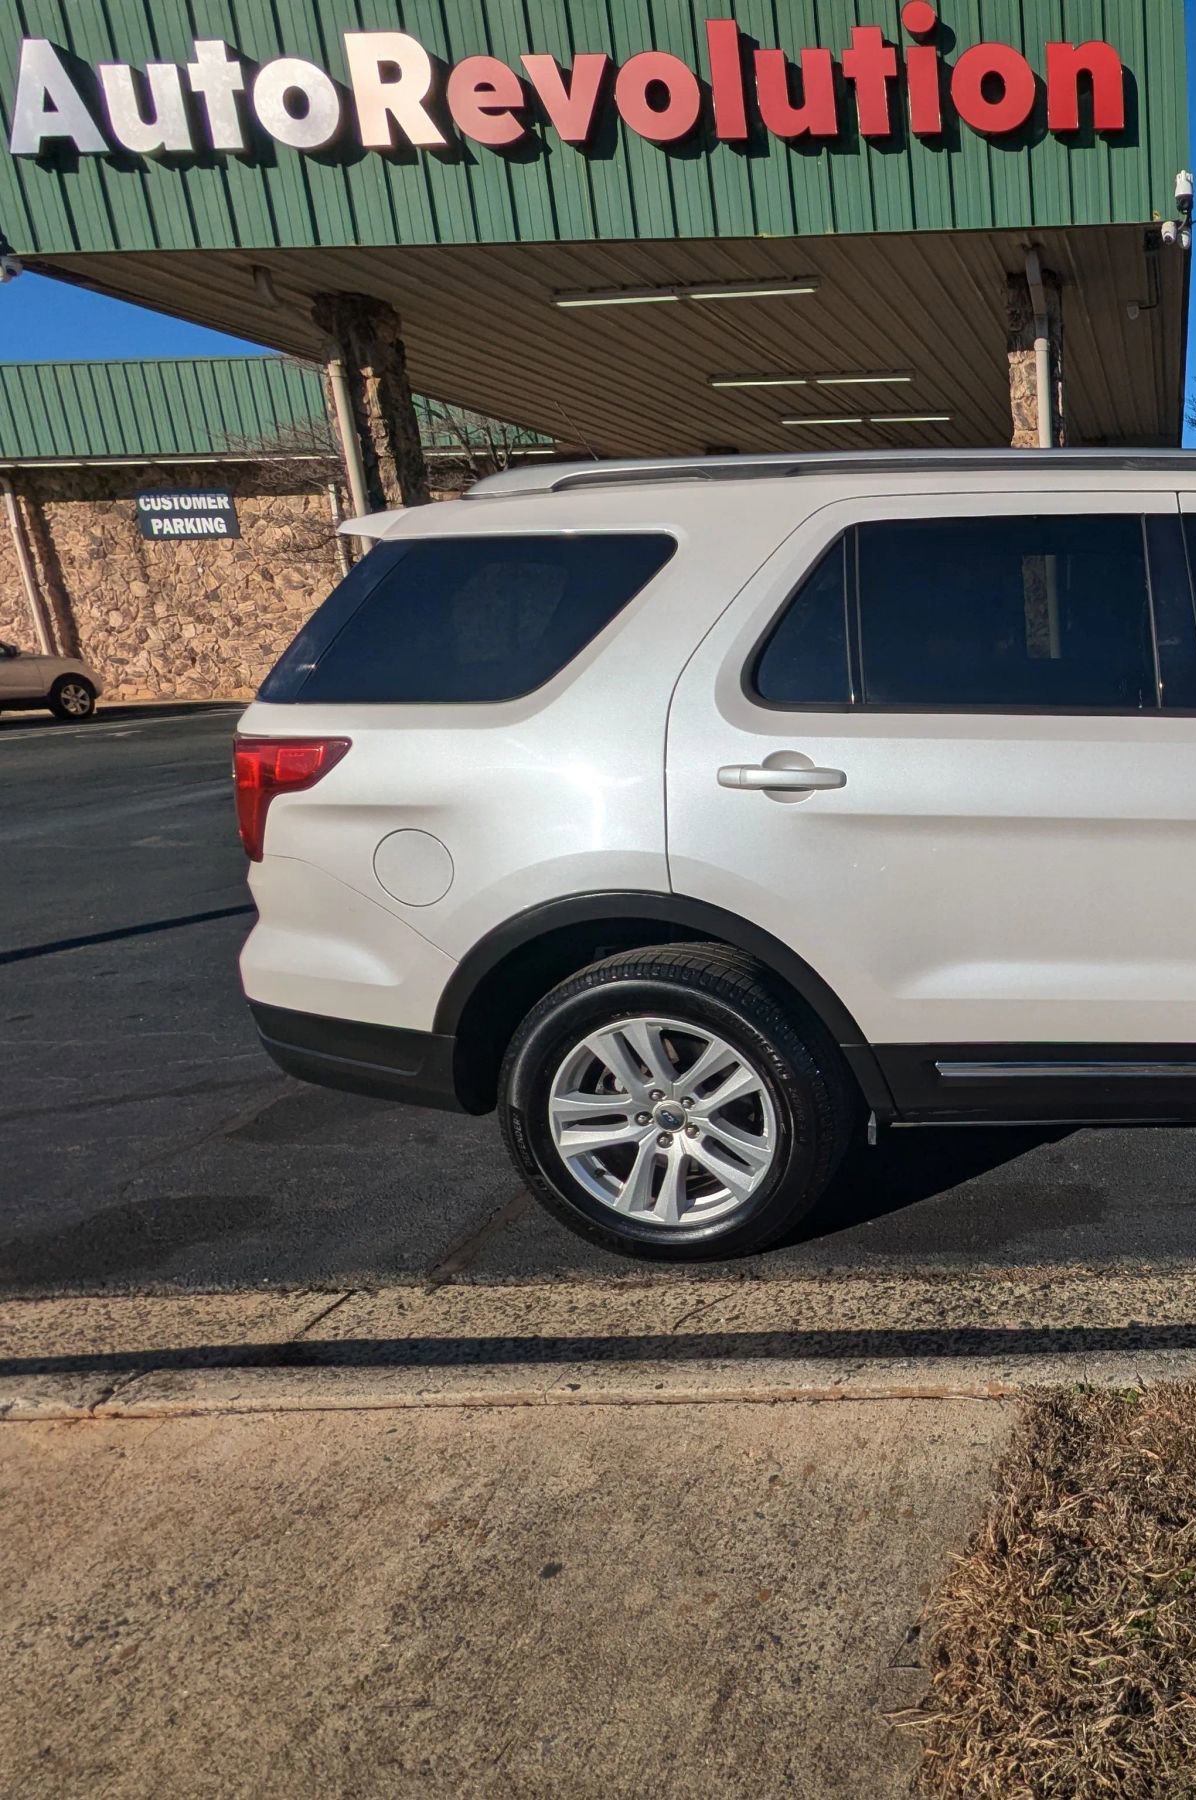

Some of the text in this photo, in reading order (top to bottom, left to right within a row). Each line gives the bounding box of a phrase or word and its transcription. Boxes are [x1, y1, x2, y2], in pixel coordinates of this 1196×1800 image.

[9, 0, 1125, 156] AutoRevolution
[138, 494, 231, 512] CUSTOMER
[151, 517, 228, 535] PARKING
